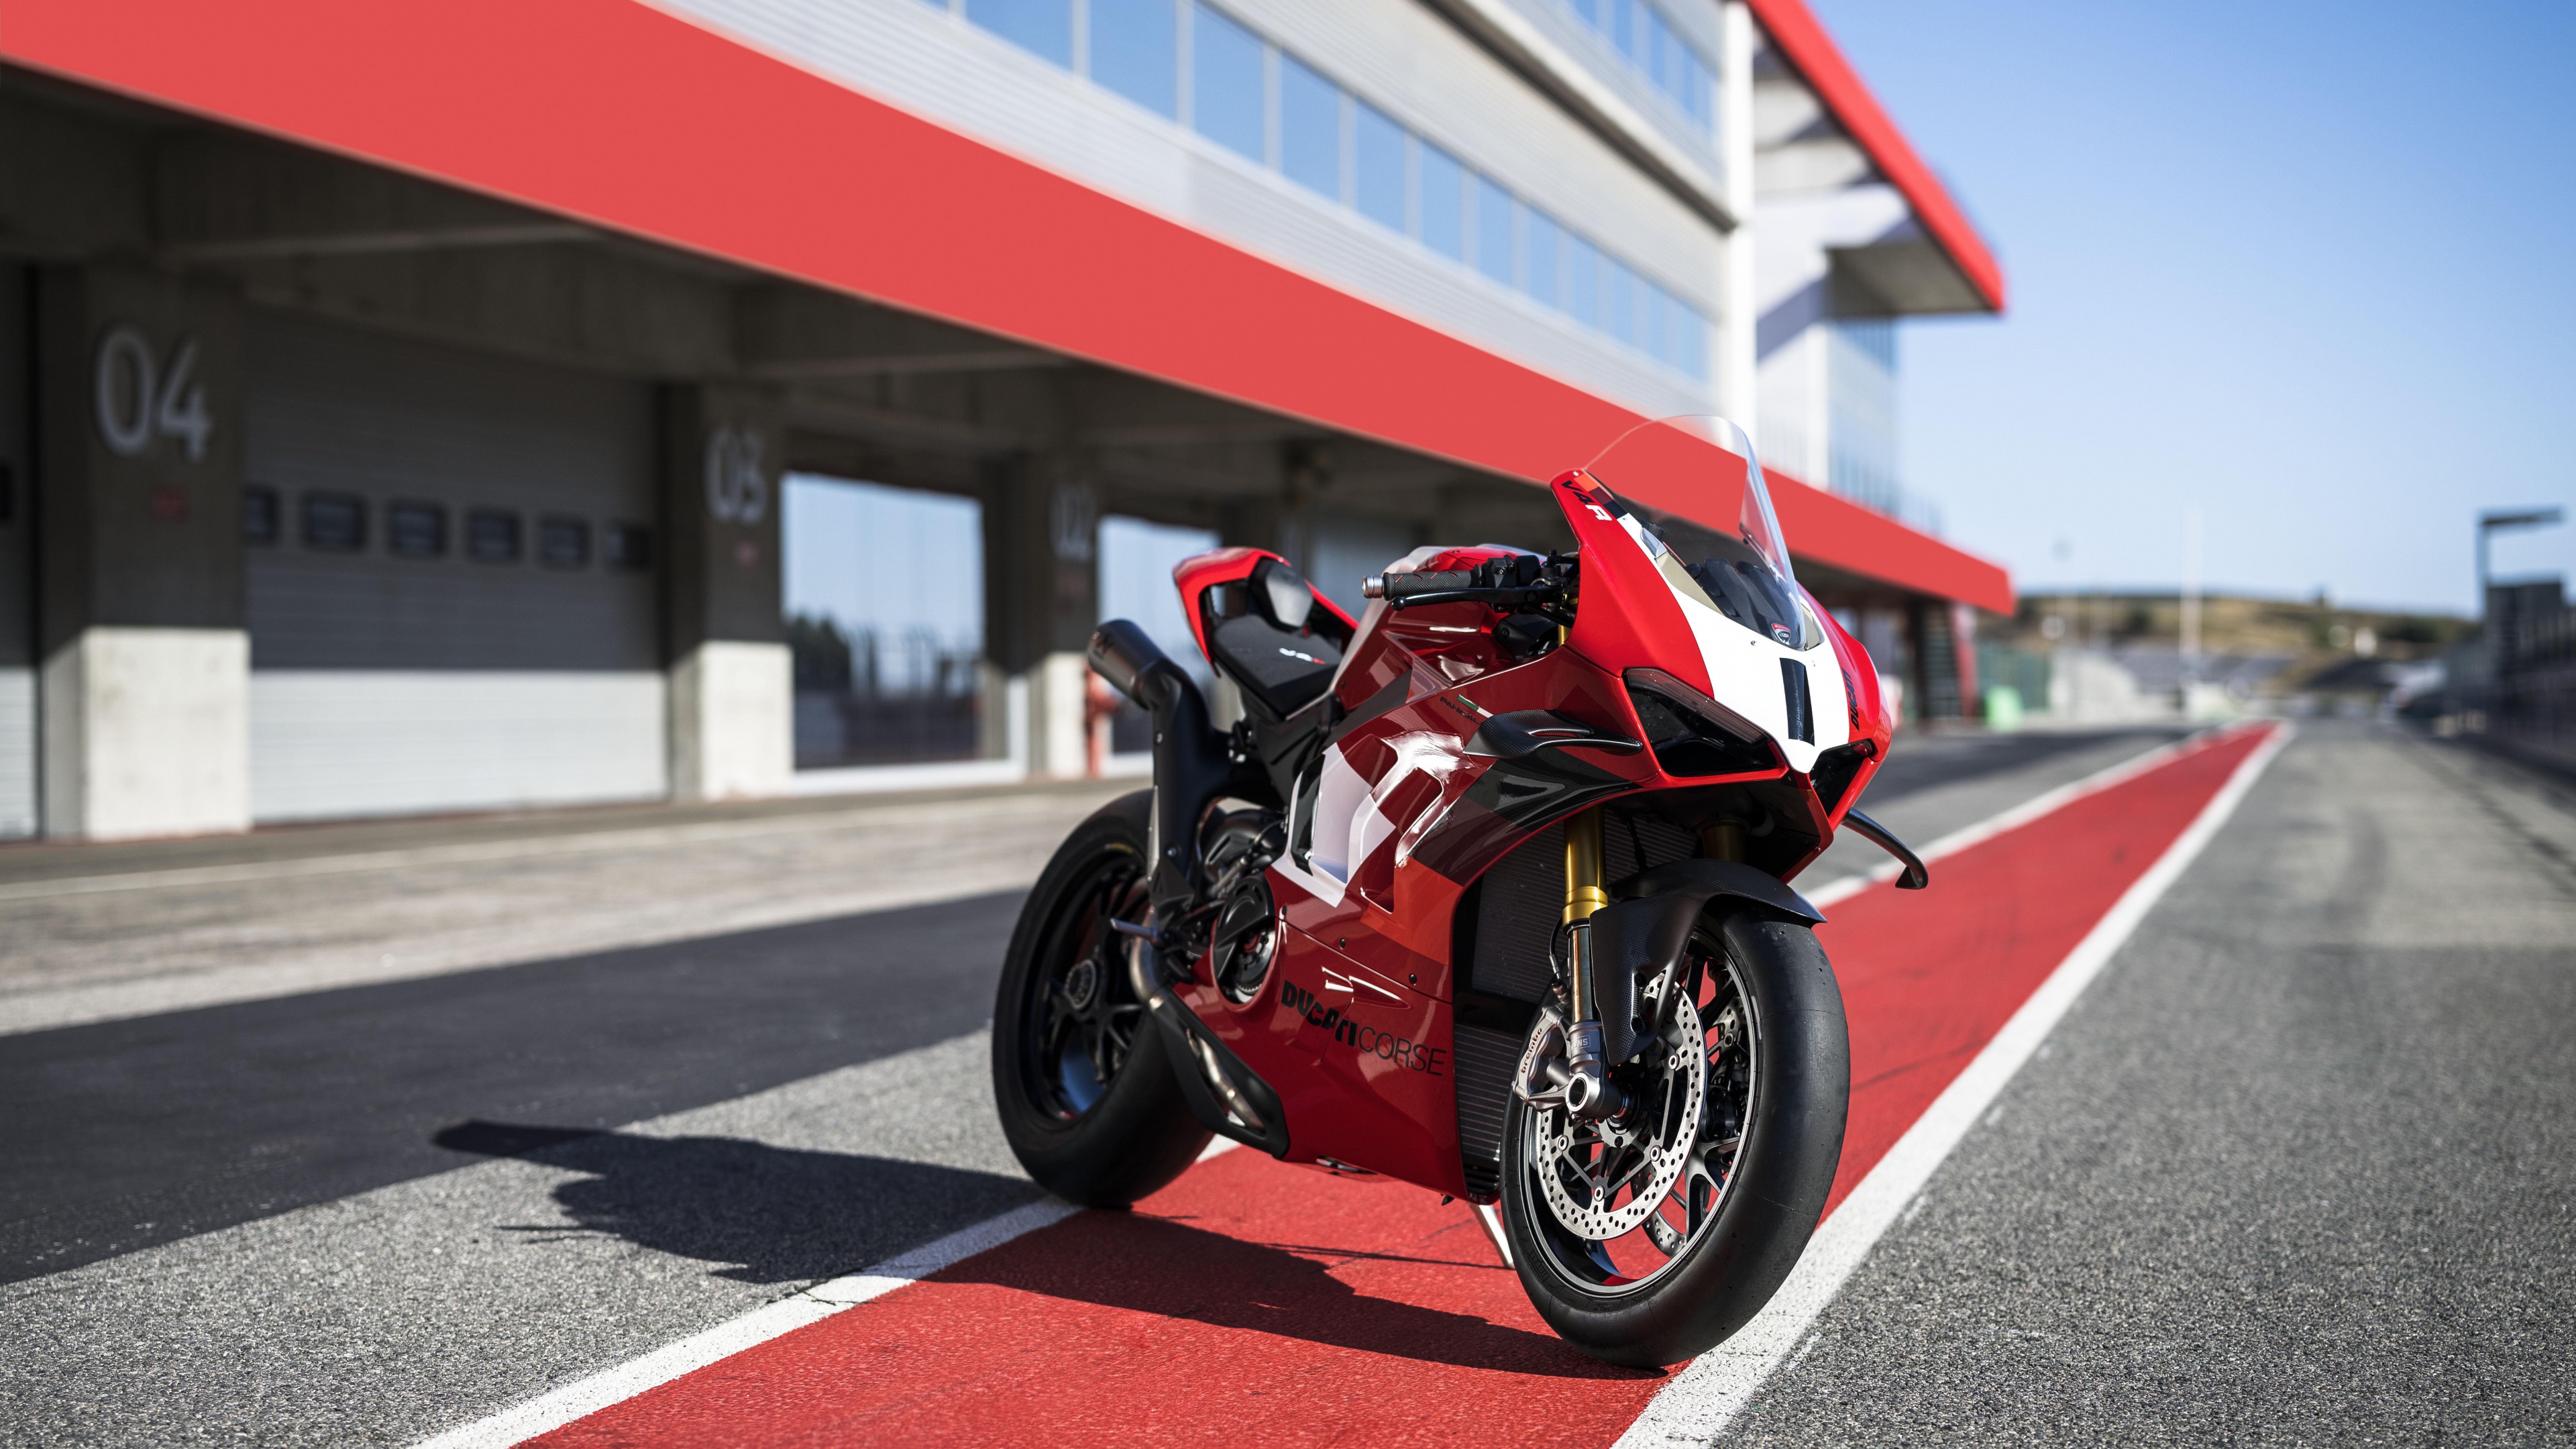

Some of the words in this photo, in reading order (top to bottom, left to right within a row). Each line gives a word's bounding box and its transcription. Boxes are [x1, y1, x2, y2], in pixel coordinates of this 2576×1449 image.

[95, 328, 212, 461] 04
[706, 426, 767, 522] 03
[1841, 667, 1860, 731] DUCATI
[1520, 1028, 1542, 1073] brembo
